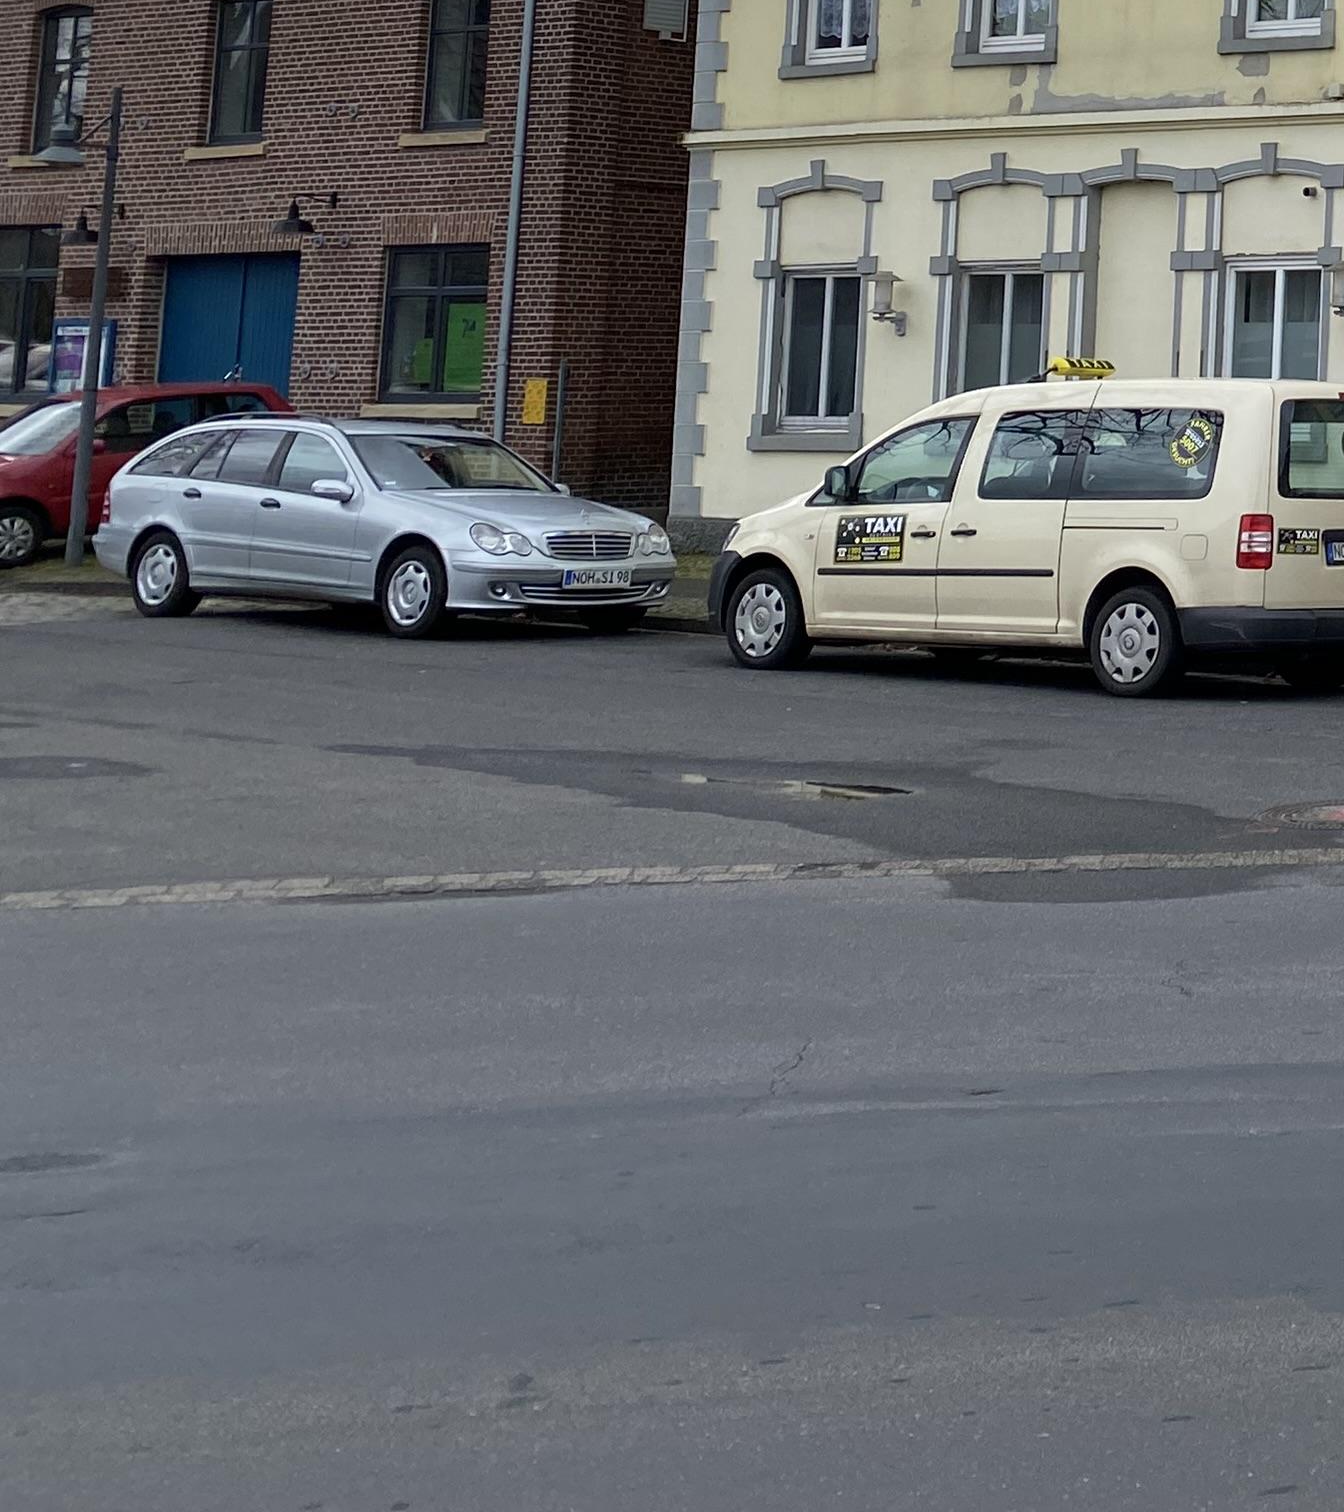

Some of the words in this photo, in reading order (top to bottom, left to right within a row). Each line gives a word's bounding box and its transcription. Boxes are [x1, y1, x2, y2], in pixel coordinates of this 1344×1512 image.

[864, 517, 904, 534] TAXI
[1295, 530, 1318, 539] TAXI
[572, 571, 596, 584] NOH
